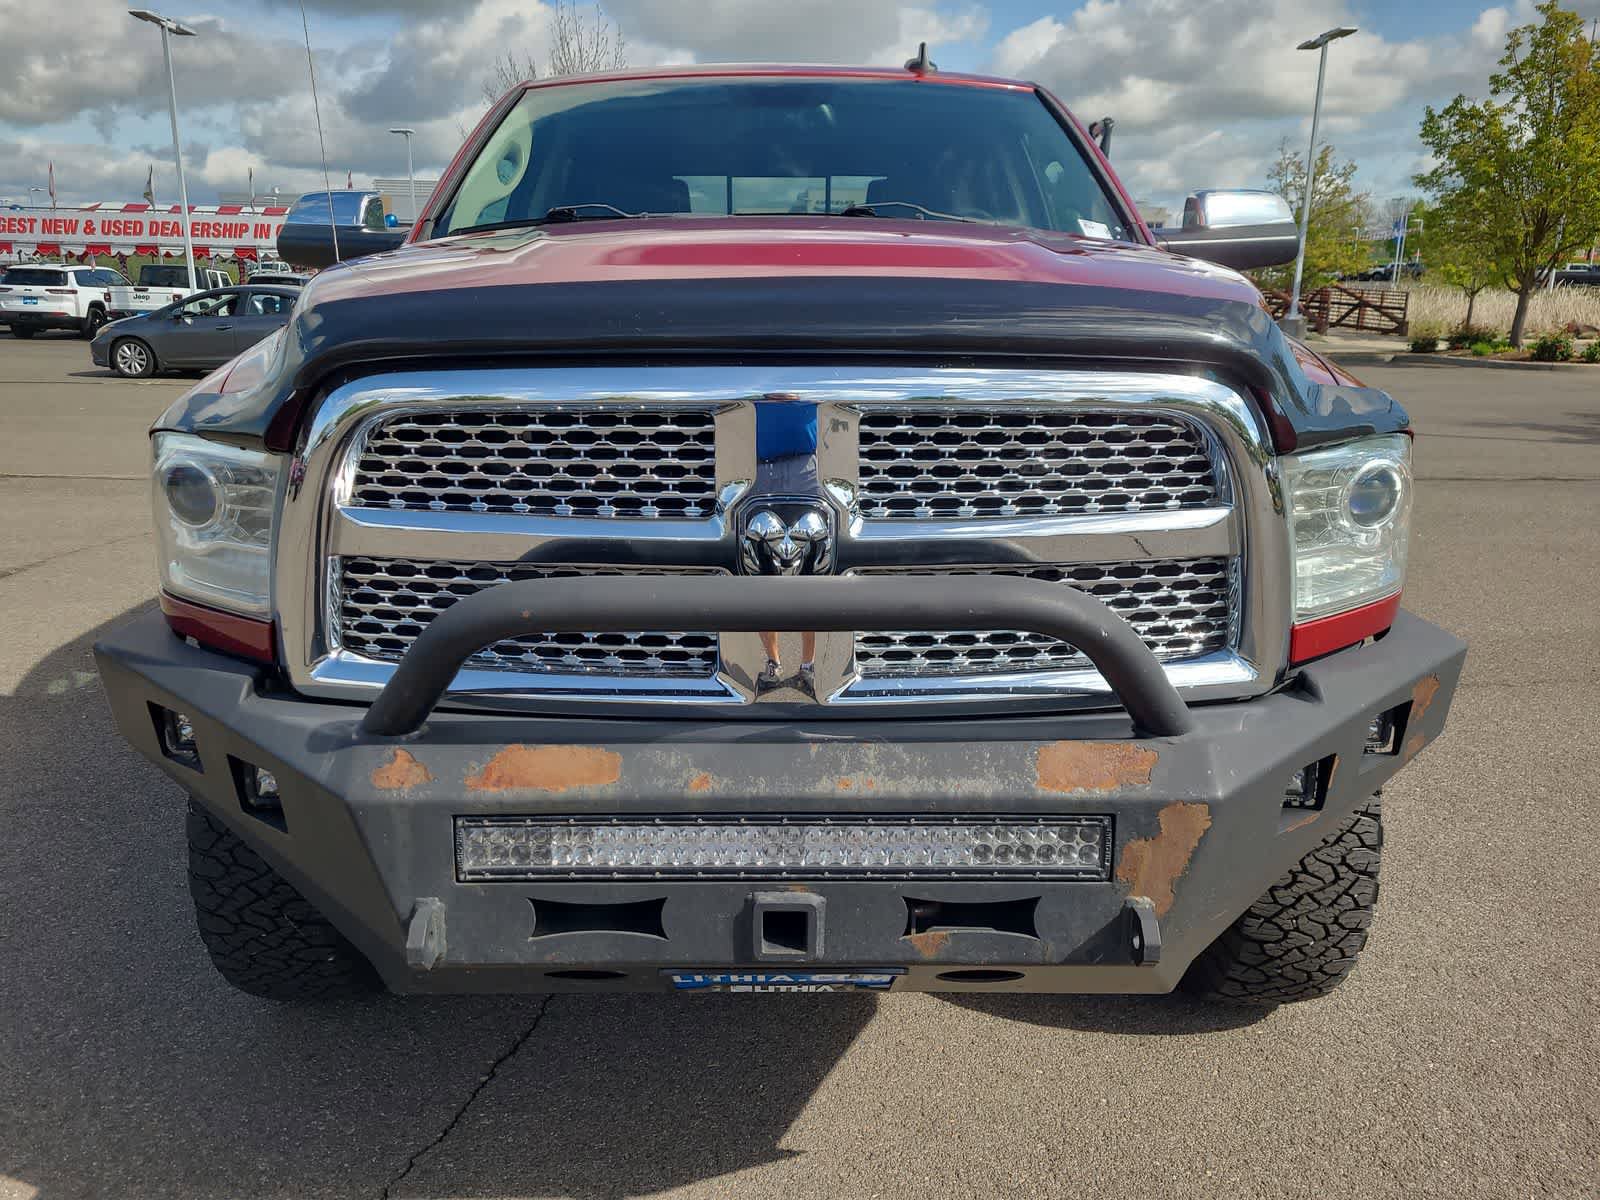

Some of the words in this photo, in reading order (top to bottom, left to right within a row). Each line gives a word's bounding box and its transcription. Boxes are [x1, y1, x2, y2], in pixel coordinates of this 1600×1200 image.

[41, 218, 79, 235] NEW
[83, 219, 97, 236] &
[101, 219, 144, 237] USED
[149, 220, 250, 239] DEAERSHIP
[253, 223, 271, 239] IN
[133, 293, 150, 301] Jeep
